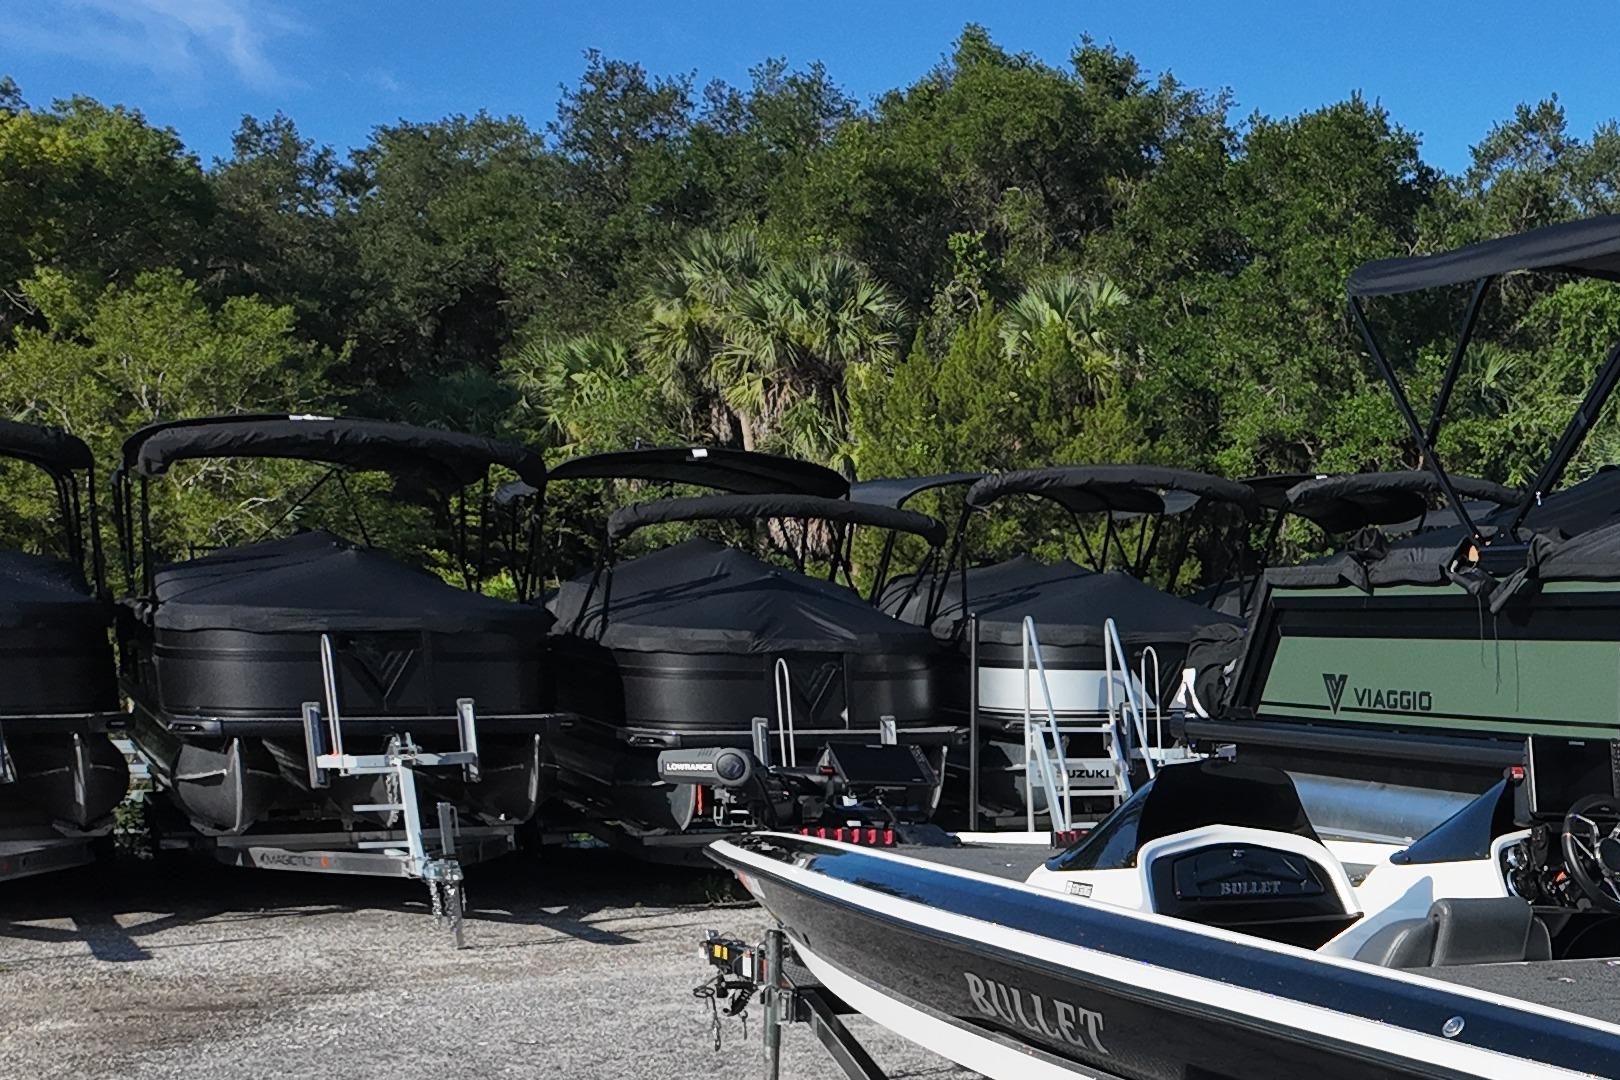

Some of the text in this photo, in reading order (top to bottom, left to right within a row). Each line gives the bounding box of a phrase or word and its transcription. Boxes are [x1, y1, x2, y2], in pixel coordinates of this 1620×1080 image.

[1353, 687, 1433, 712] VIAGGIO
[665, 762, 714, 772] LOWRANCE
[1220, 880, 1281, 896] BULLET
[963, 971, 1111, 1056] BULLET
